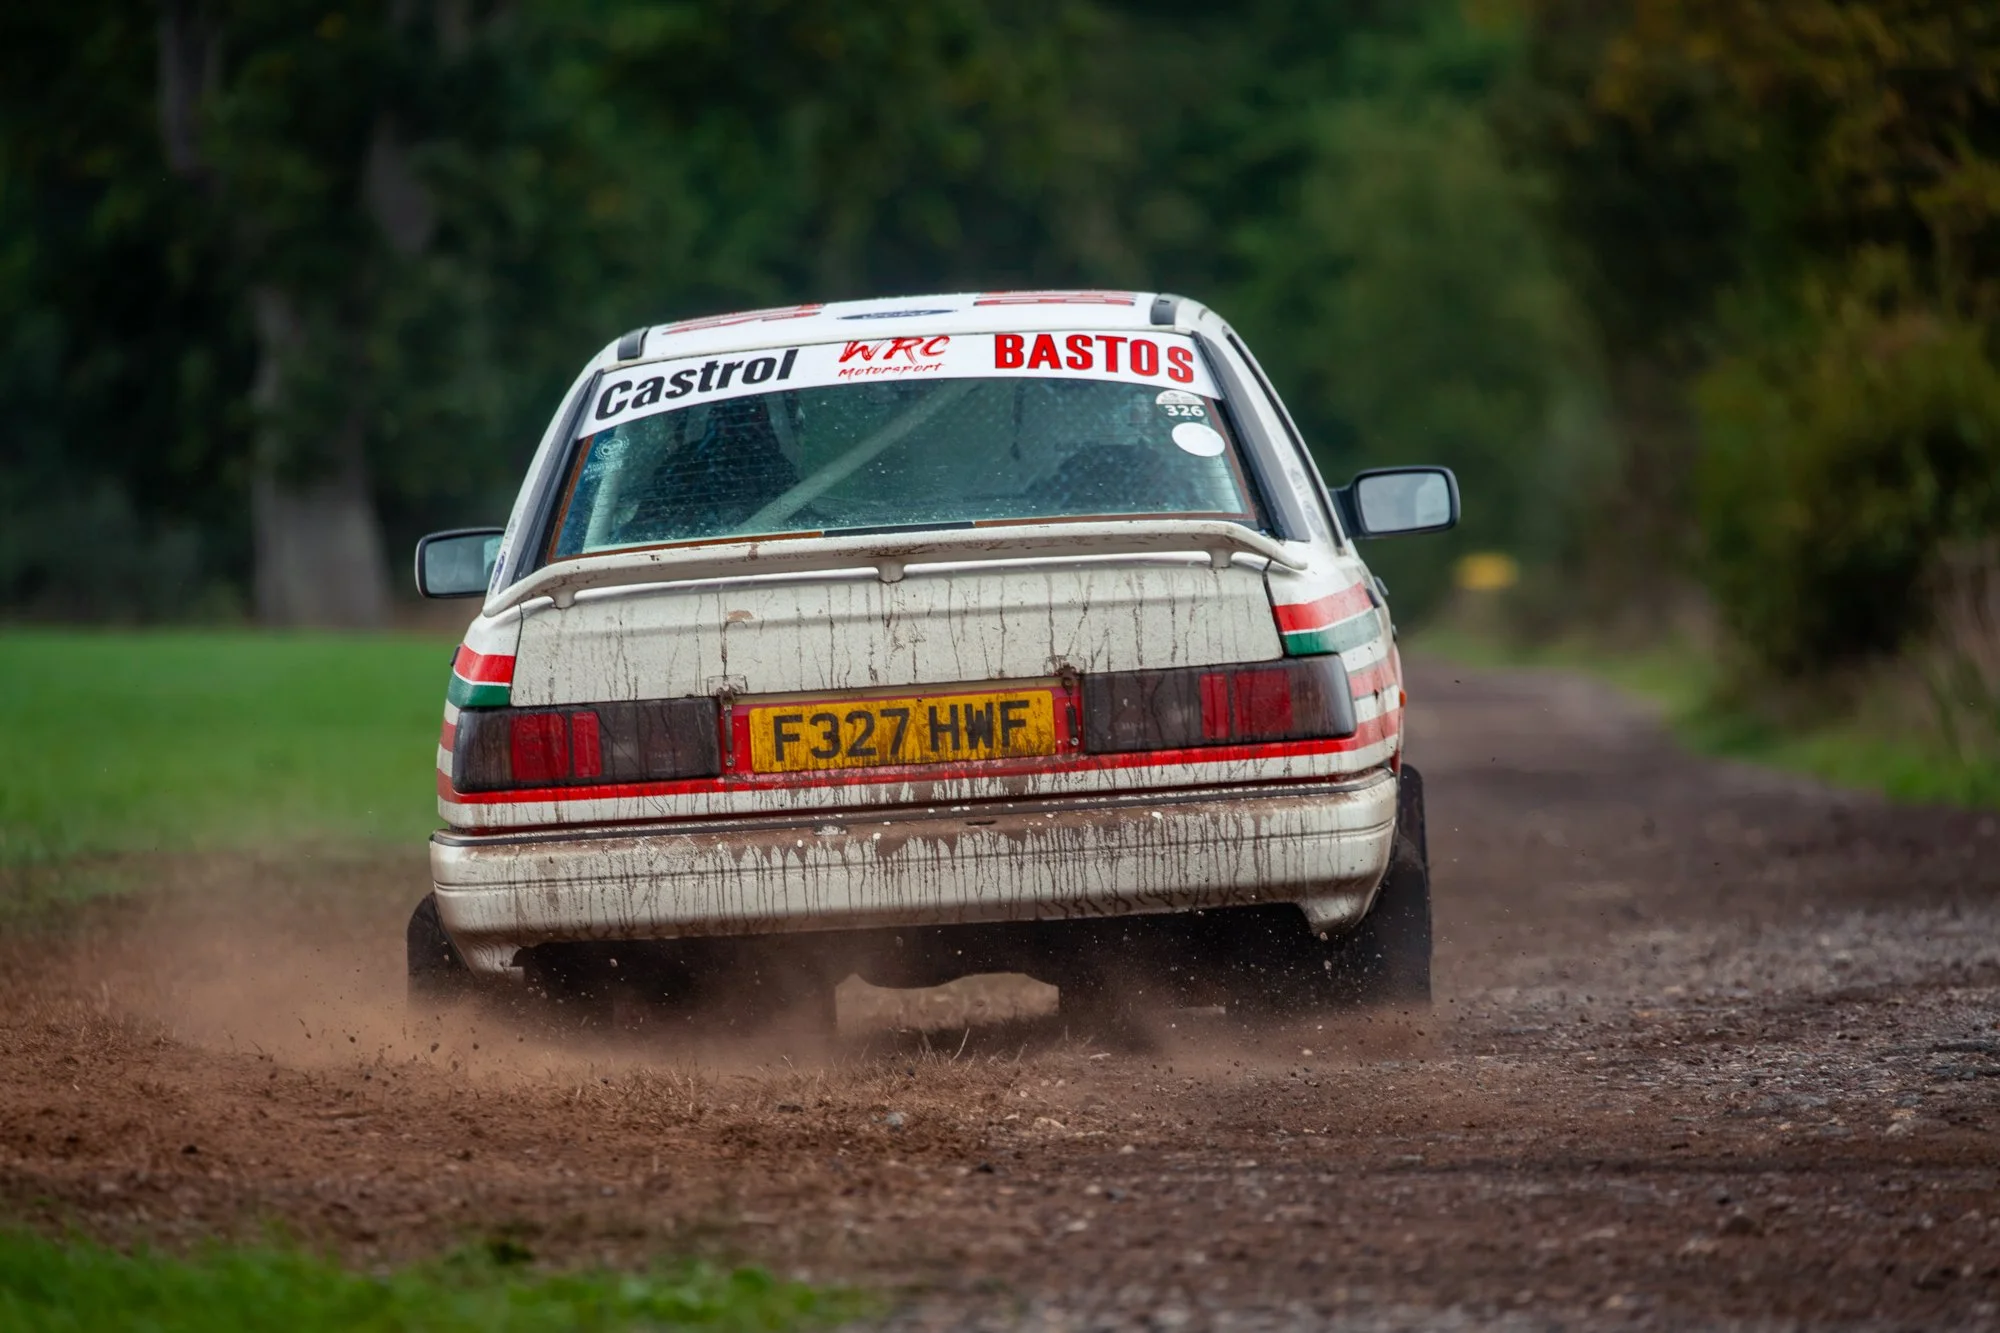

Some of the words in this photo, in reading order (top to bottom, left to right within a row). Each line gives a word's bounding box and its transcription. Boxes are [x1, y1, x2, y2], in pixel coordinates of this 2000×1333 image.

[838, 335, 951, 364] WRC
[994, 333, 1194, 384] BASTOS
[595, 348, 799, 421] Castrol
[838, 362, 944, 380] Motorsport
[1164, 404, 1205, 417] 326
[773, 707, 910, 762] F327
[928, 700, 1030, 752] HWF
